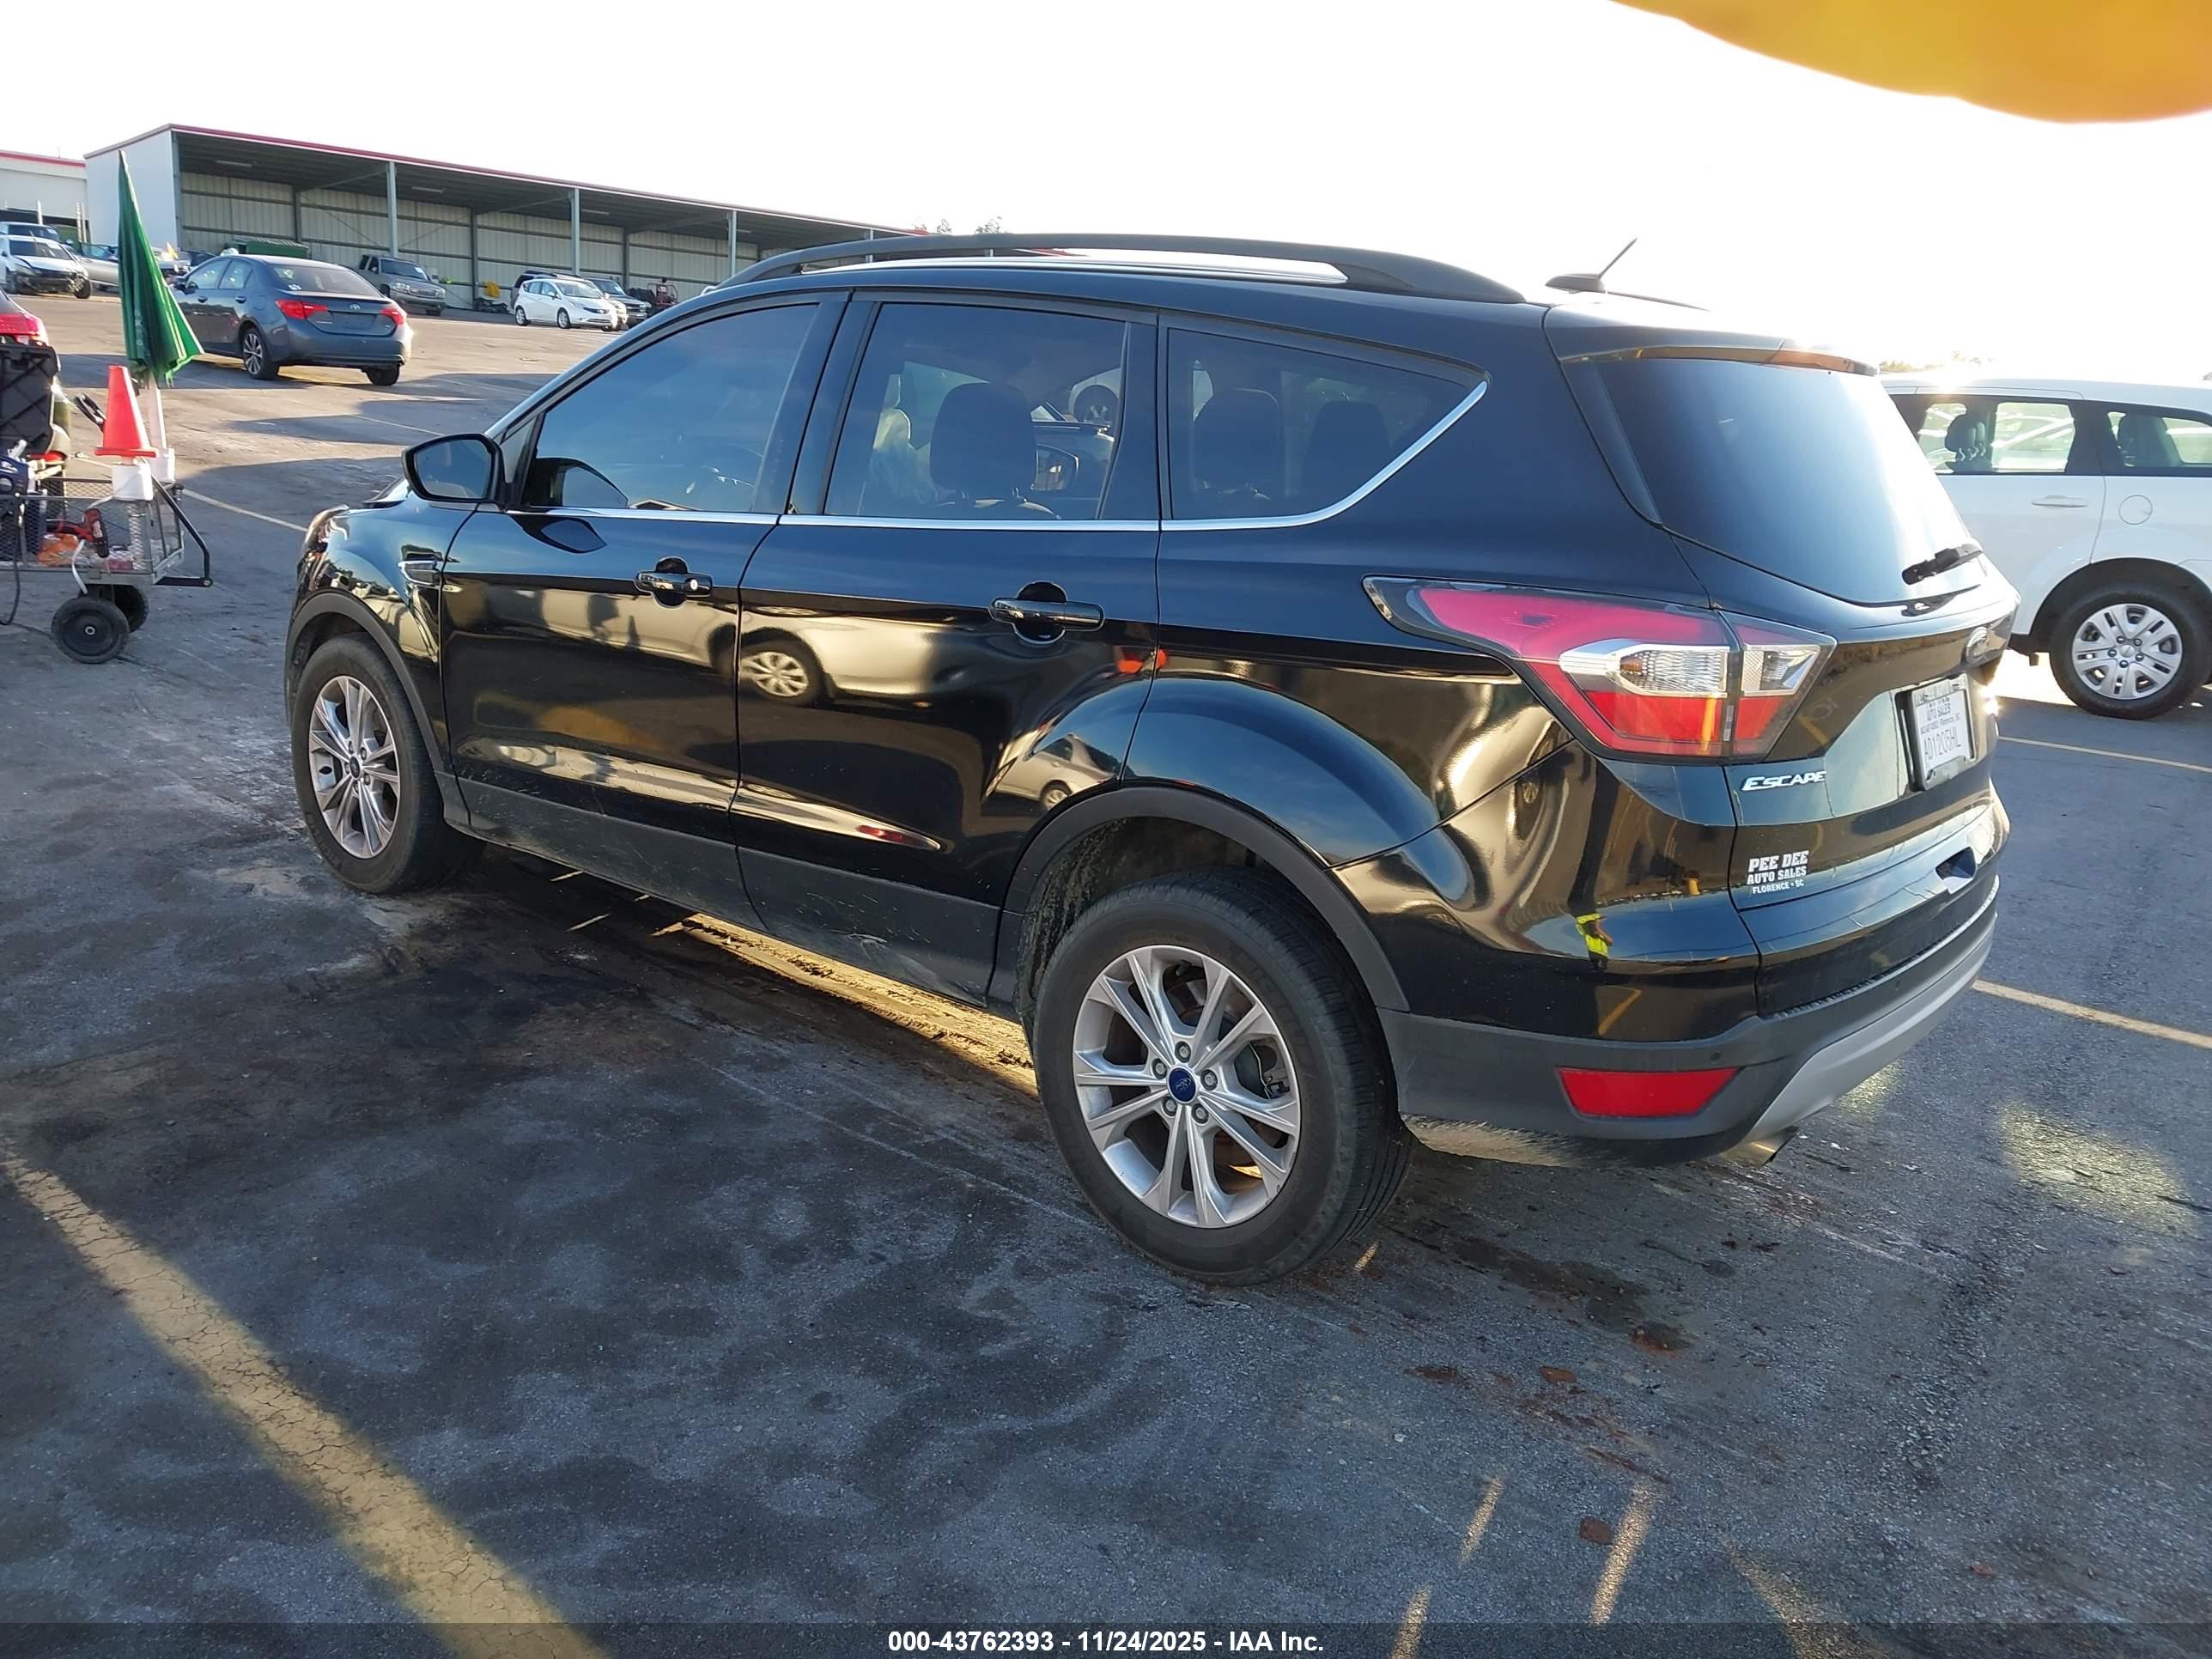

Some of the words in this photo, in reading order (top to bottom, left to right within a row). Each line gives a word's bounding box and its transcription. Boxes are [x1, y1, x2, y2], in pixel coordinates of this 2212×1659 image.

[1748, 855, 1780, 872] PEE
[1781, 850, 1810, 867] DEE
[1747, 870, 1775, 884] AUTO
[1778, 865, 1808, 881] SALES
[1752, 884, 1790, 895] FLORENCE
[1795, 878, 1805, 887] SC
